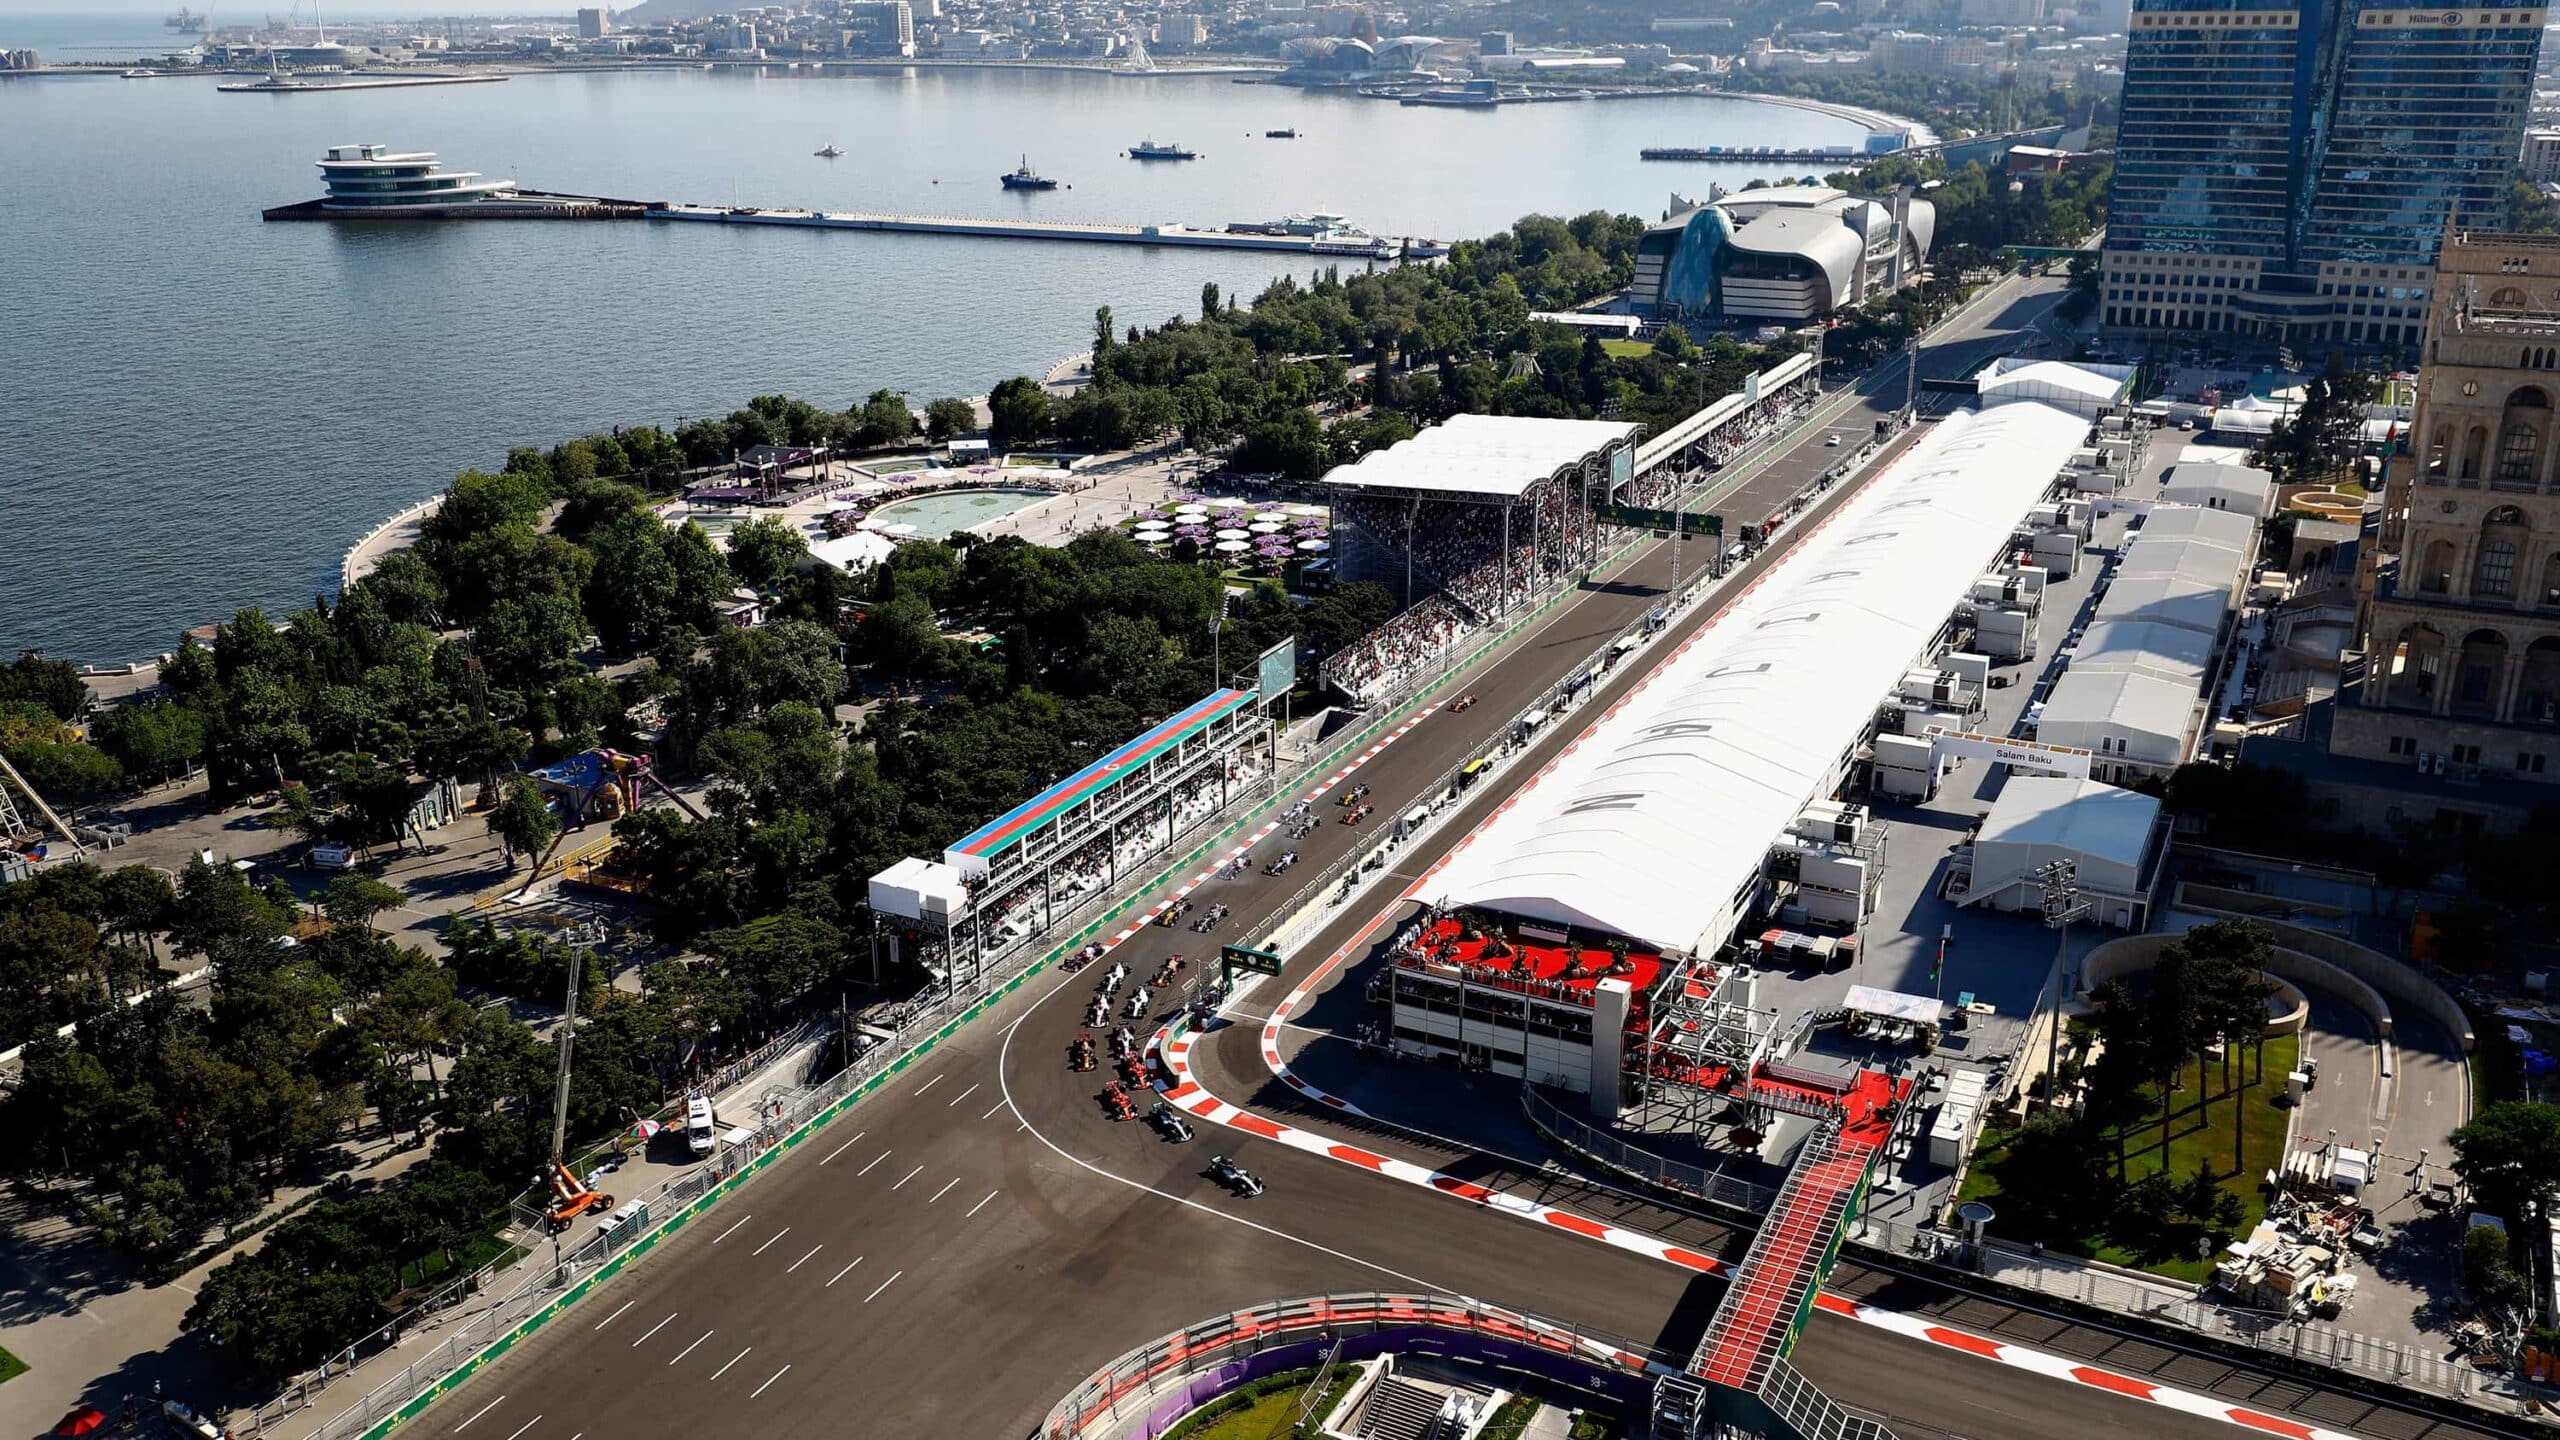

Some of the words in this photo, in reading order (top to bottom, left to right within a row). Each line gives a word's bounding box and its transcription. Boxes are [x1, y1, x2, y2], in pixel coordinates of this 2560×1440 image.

[2408, 14, 2439, 24] Hilton
[1600, 516, 1626, 525] ROLEX
[1643, 521, 1670, 529] ROLEX
[1687, 525, 1715, 534] ROLEX
[1996, 749, 2025, 761] Salam
[2028, 754, 2053, 765] Baku
